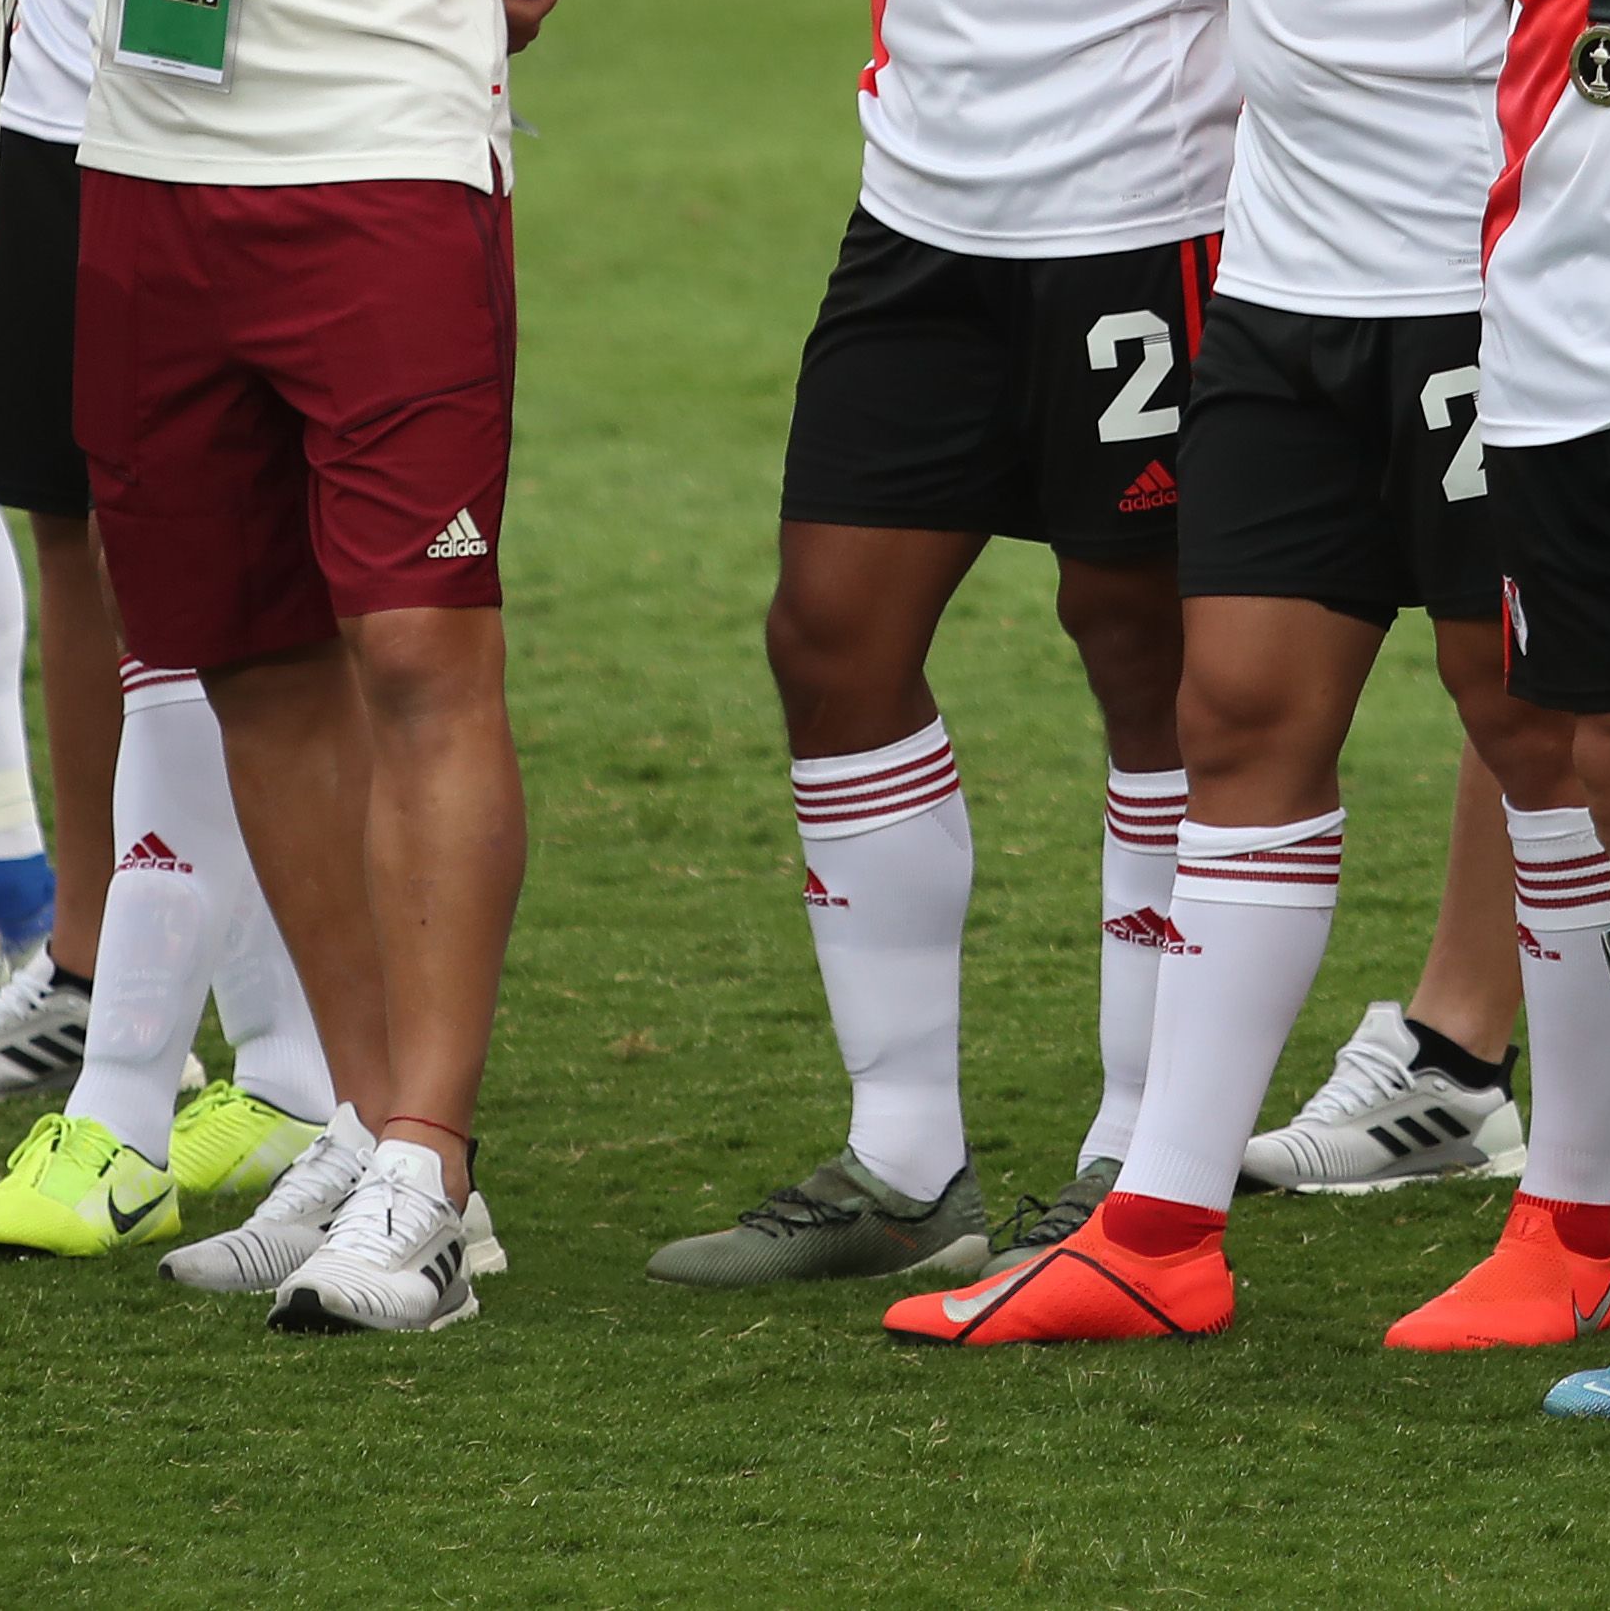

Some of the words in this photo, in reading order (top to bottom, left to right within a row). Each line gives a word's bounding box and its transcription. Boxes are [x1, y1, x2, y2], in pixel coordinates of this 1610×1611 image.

[1086, 309, 1180, 443] 2
[1118, 488, 1178, 513] adida
[426, 537, 488, 559] adidas
